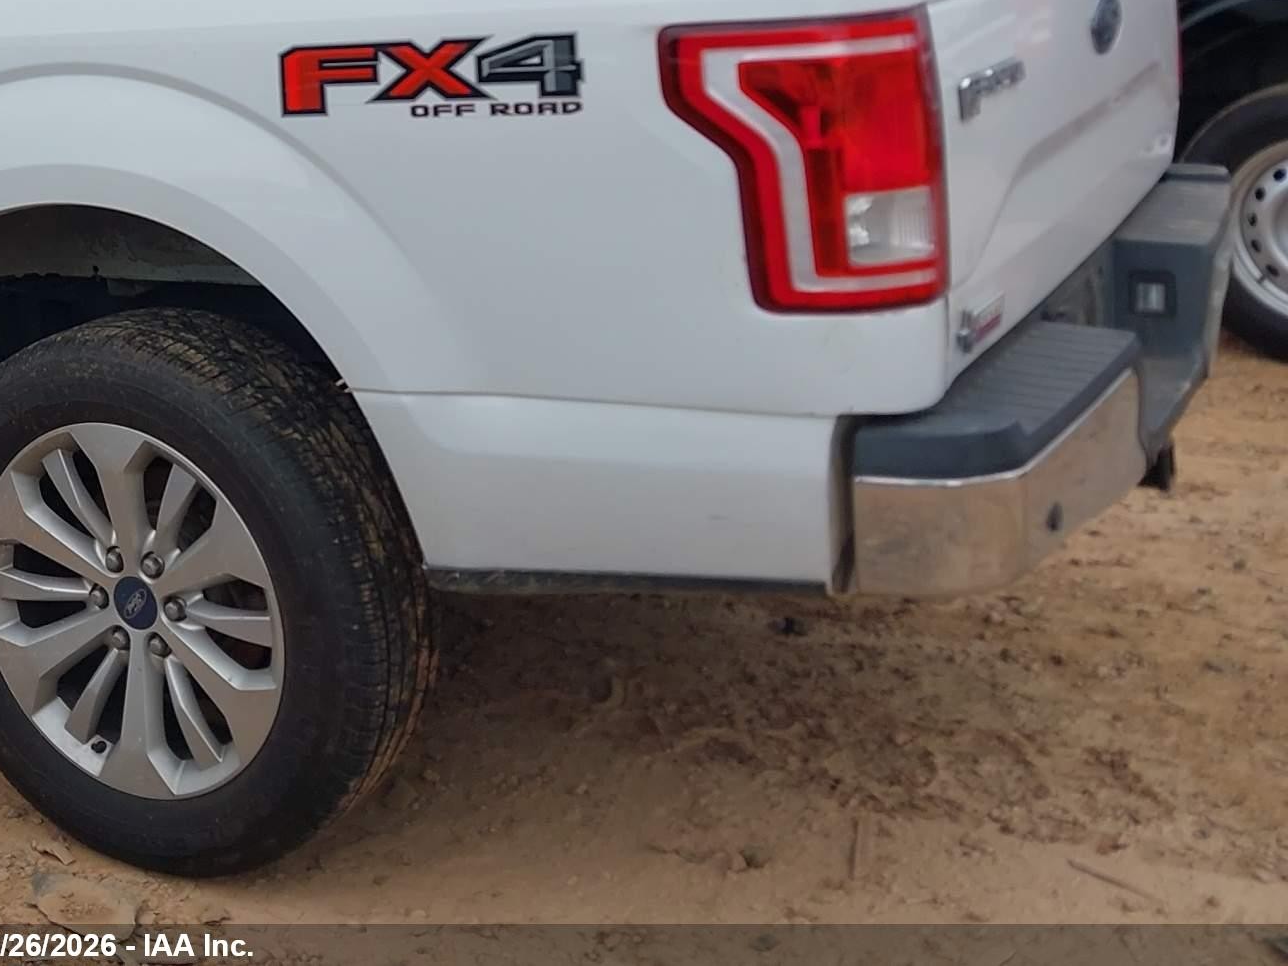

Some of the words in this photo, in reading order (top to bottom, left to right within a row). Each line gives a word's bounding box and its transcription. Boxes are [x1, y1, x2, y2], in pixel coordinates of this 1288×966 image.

[280, 32, 584, 117] FX4
[410, 104, 475, 117] OFF
[490, 101, 582, 117] ROAD
